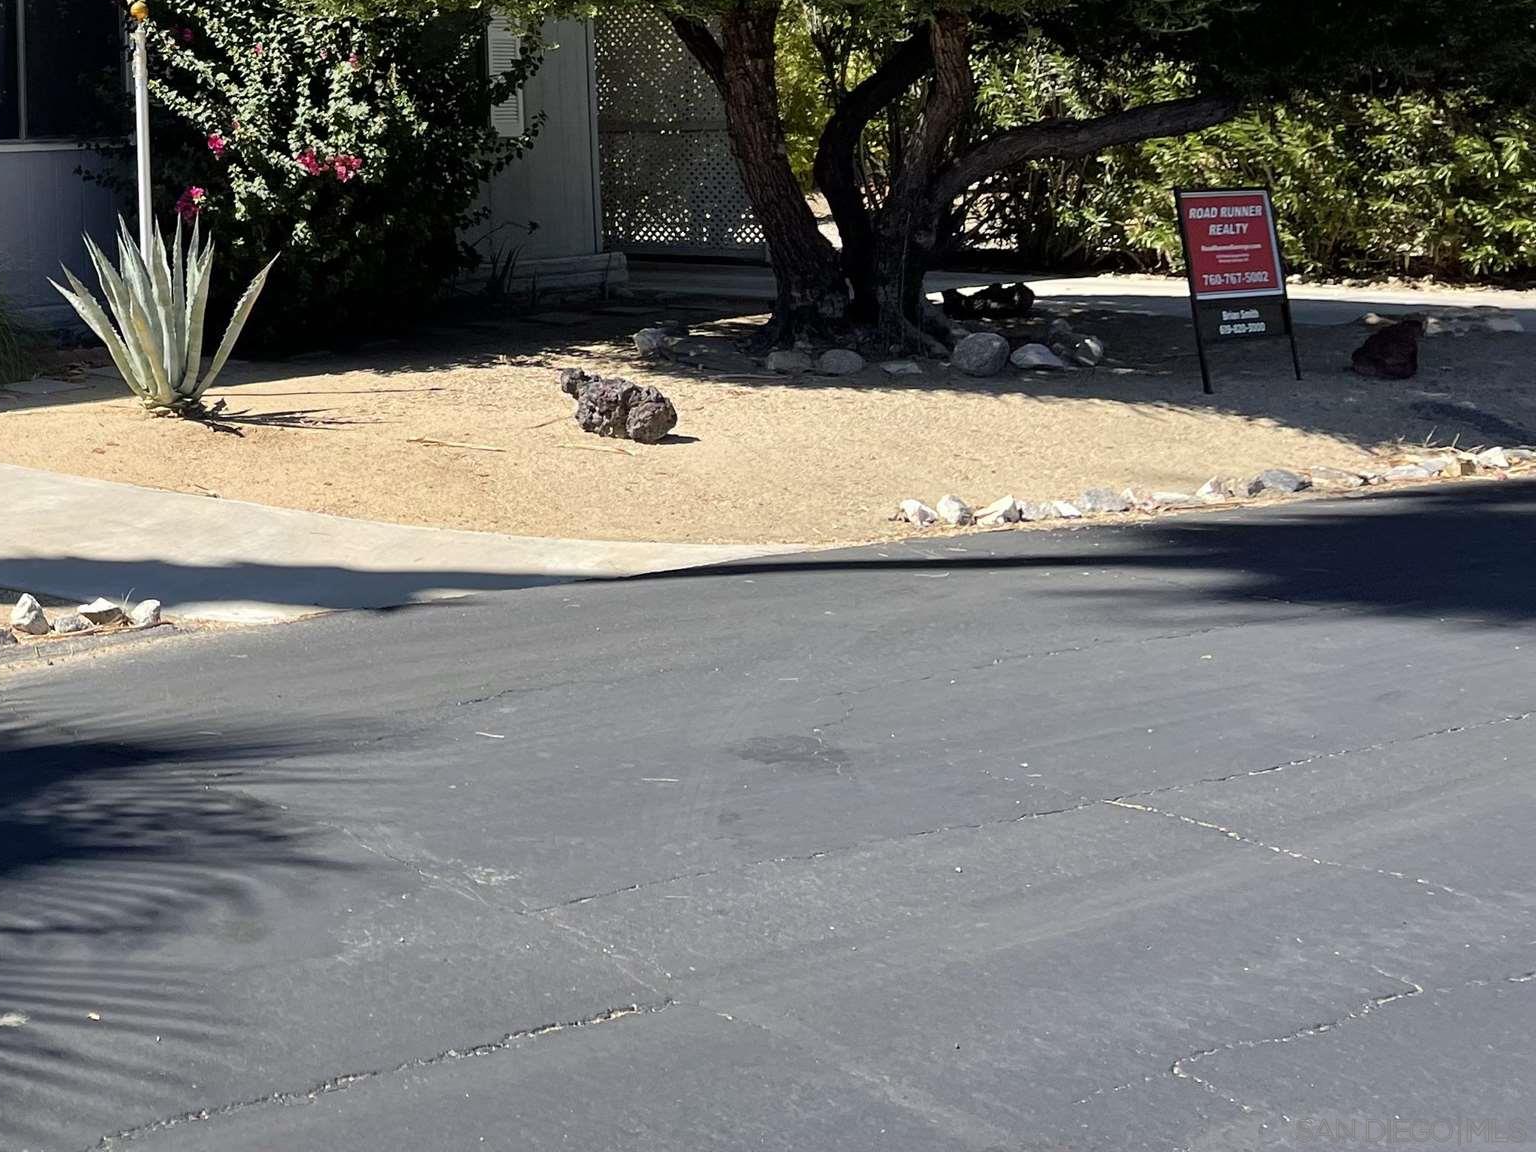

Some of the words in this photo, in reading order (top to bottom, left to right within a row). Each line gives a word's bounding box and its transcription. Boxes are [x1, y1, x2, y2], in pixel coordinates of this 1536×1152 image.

[1189, 207, 1218, 219] ROAD
[1220, 205, 1263, 217] RUNNER
[1208, 223, 1248, 235] REALTY
